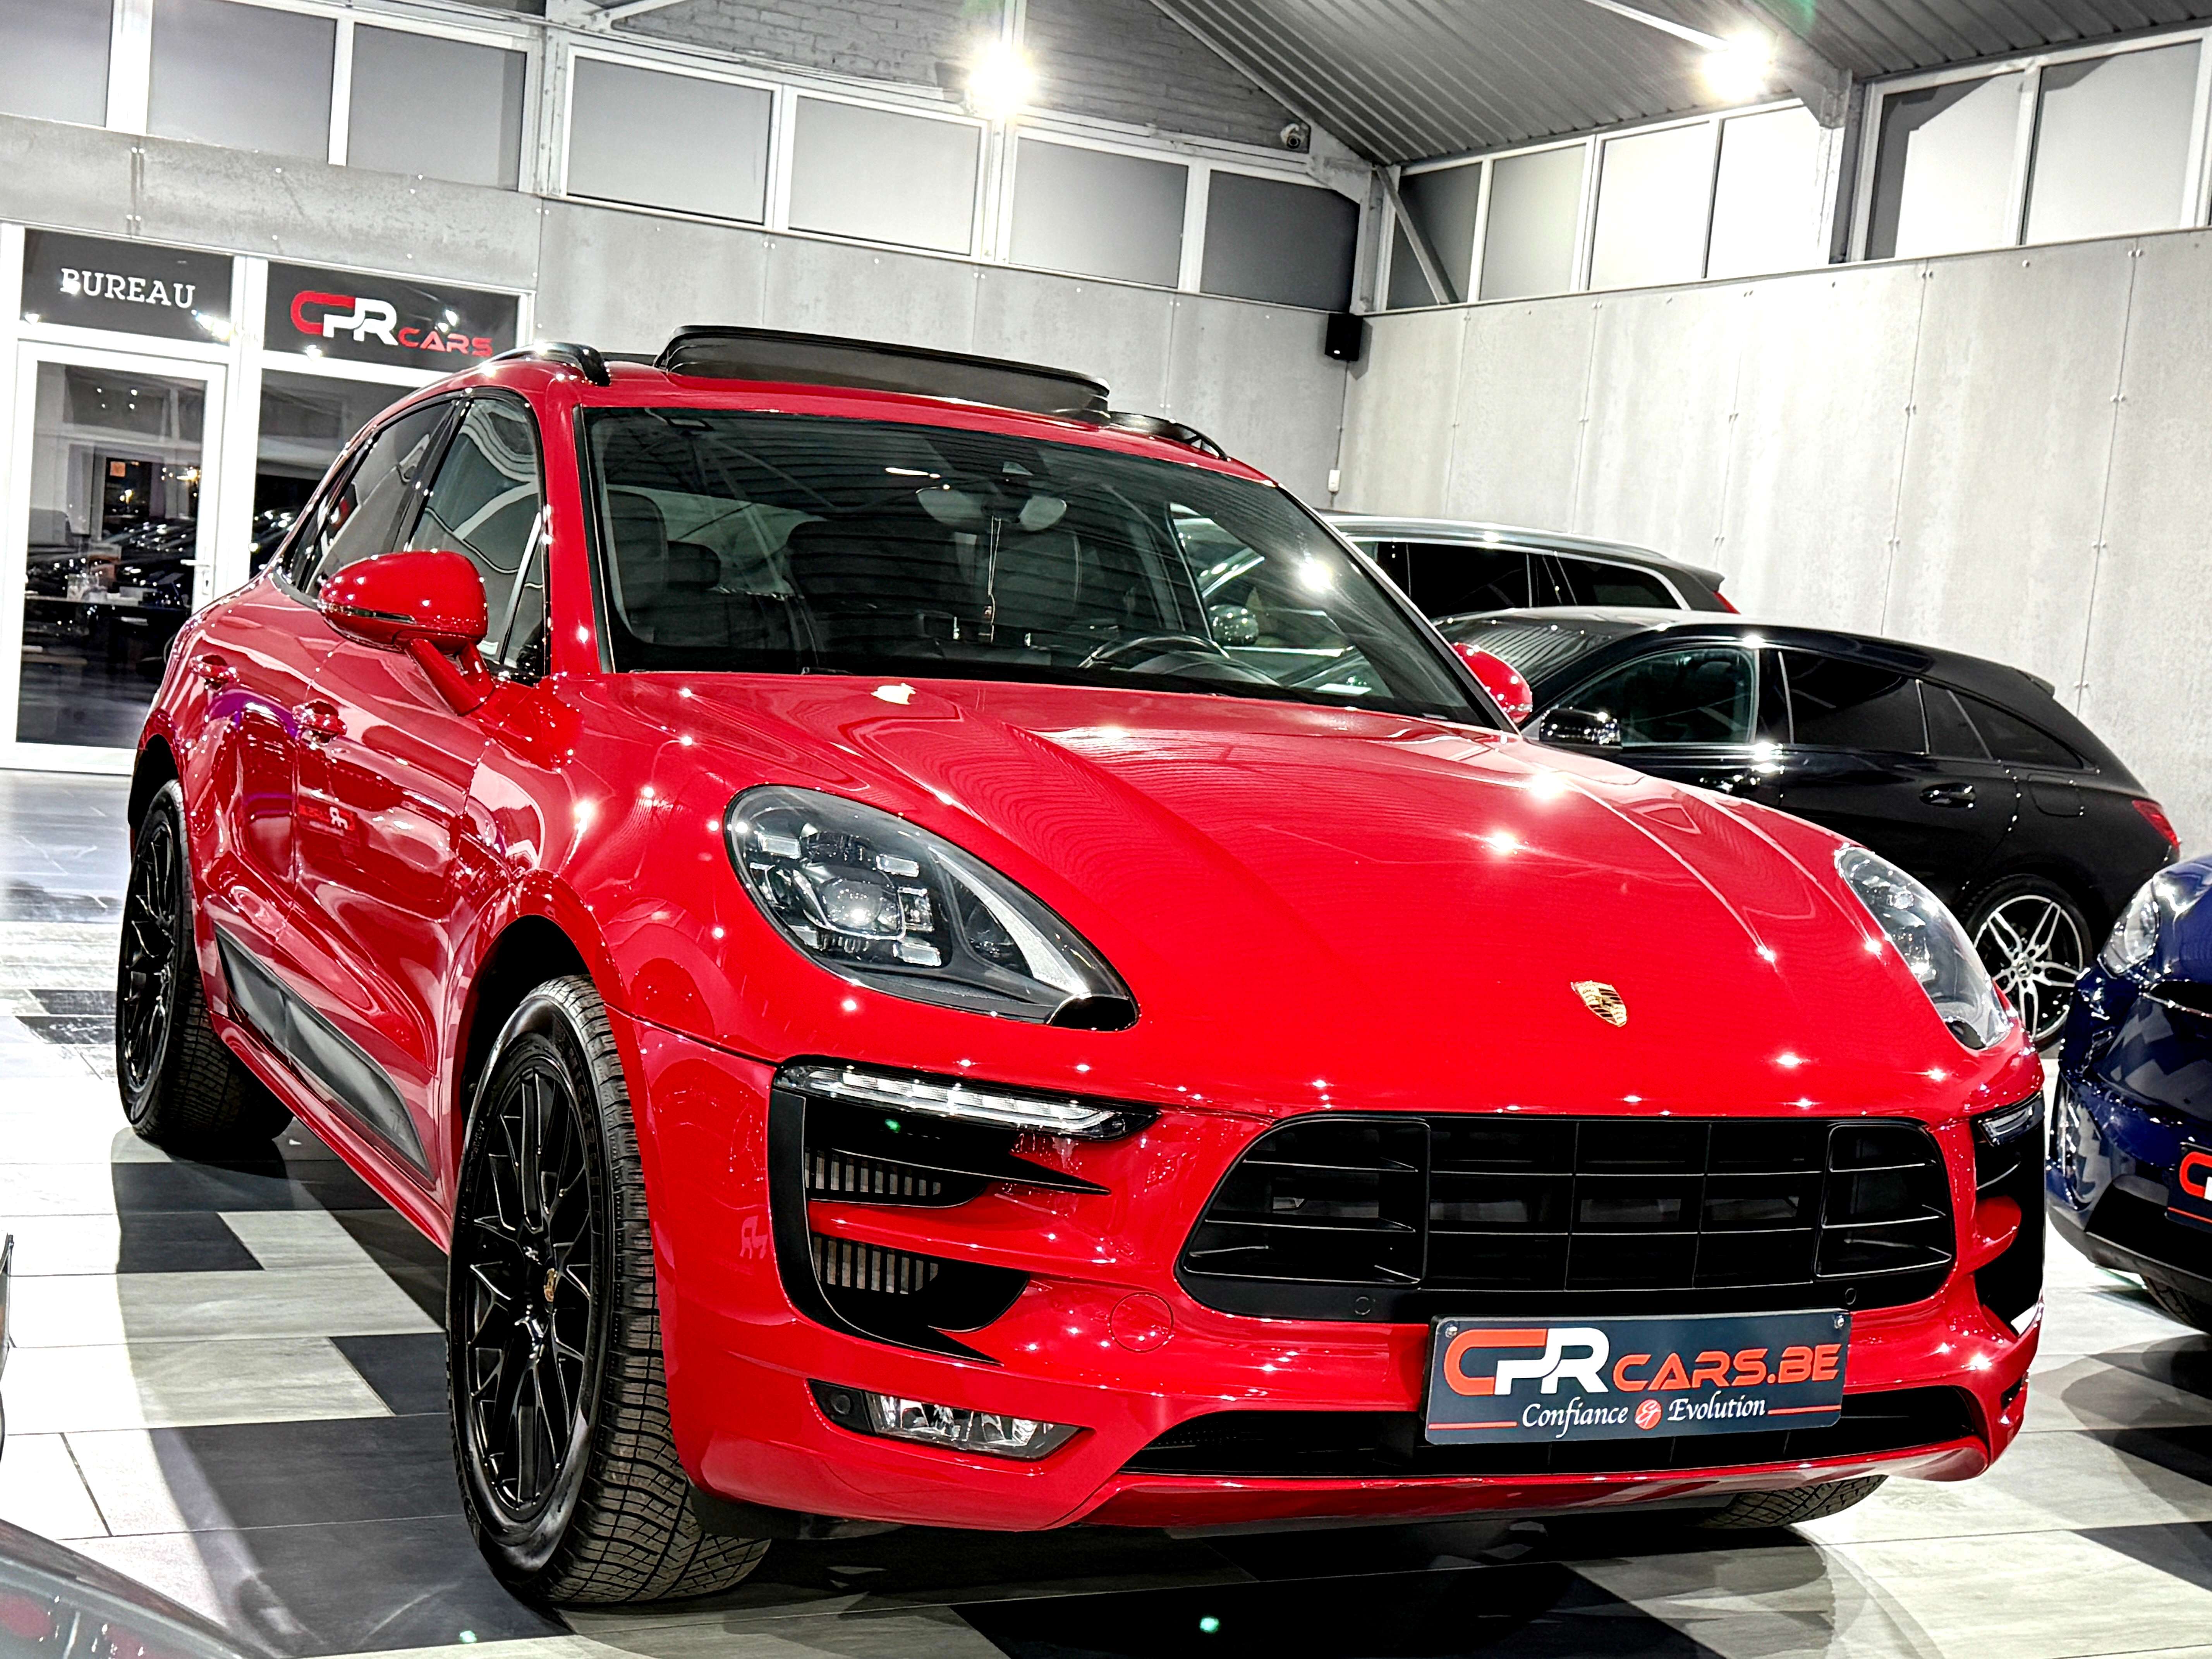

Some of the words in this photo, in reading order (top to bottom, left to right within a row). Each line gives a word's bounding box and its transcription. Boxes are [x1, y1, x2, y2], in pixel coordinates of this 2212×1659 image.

[59, 268, 196, 309] BUREAU
[290, 290, 399, 346] CPR
[398, 327, 493, 357] CARS
[1443, 1327, 1609, 1396] CPR
[1613, 1343, 1841, 1392] CARS.BE
[1522, 1396, 1629, 1438] Confiance
[1667, 1391, 1766, 1422] Evolution
